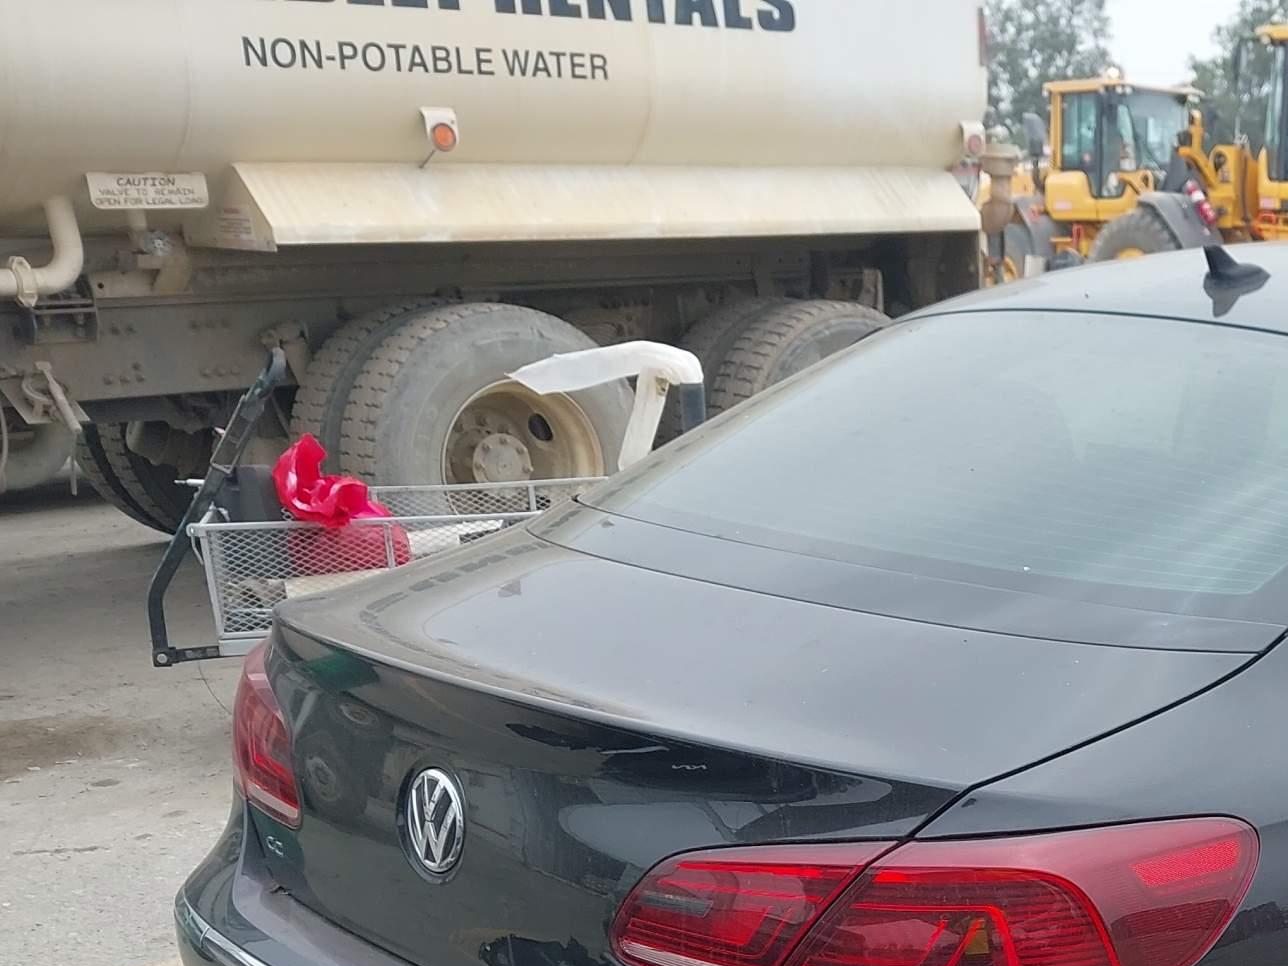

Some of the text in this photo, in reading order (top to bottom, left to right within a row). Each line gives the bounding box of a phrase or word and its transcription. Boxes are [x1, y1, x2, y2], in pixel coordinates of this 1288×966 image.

[494, 0, 797, 32] NTALS
[241, 36, 610, 80] NON-POTABLE WATER
[116, 176, 176, 187] CAUTION
